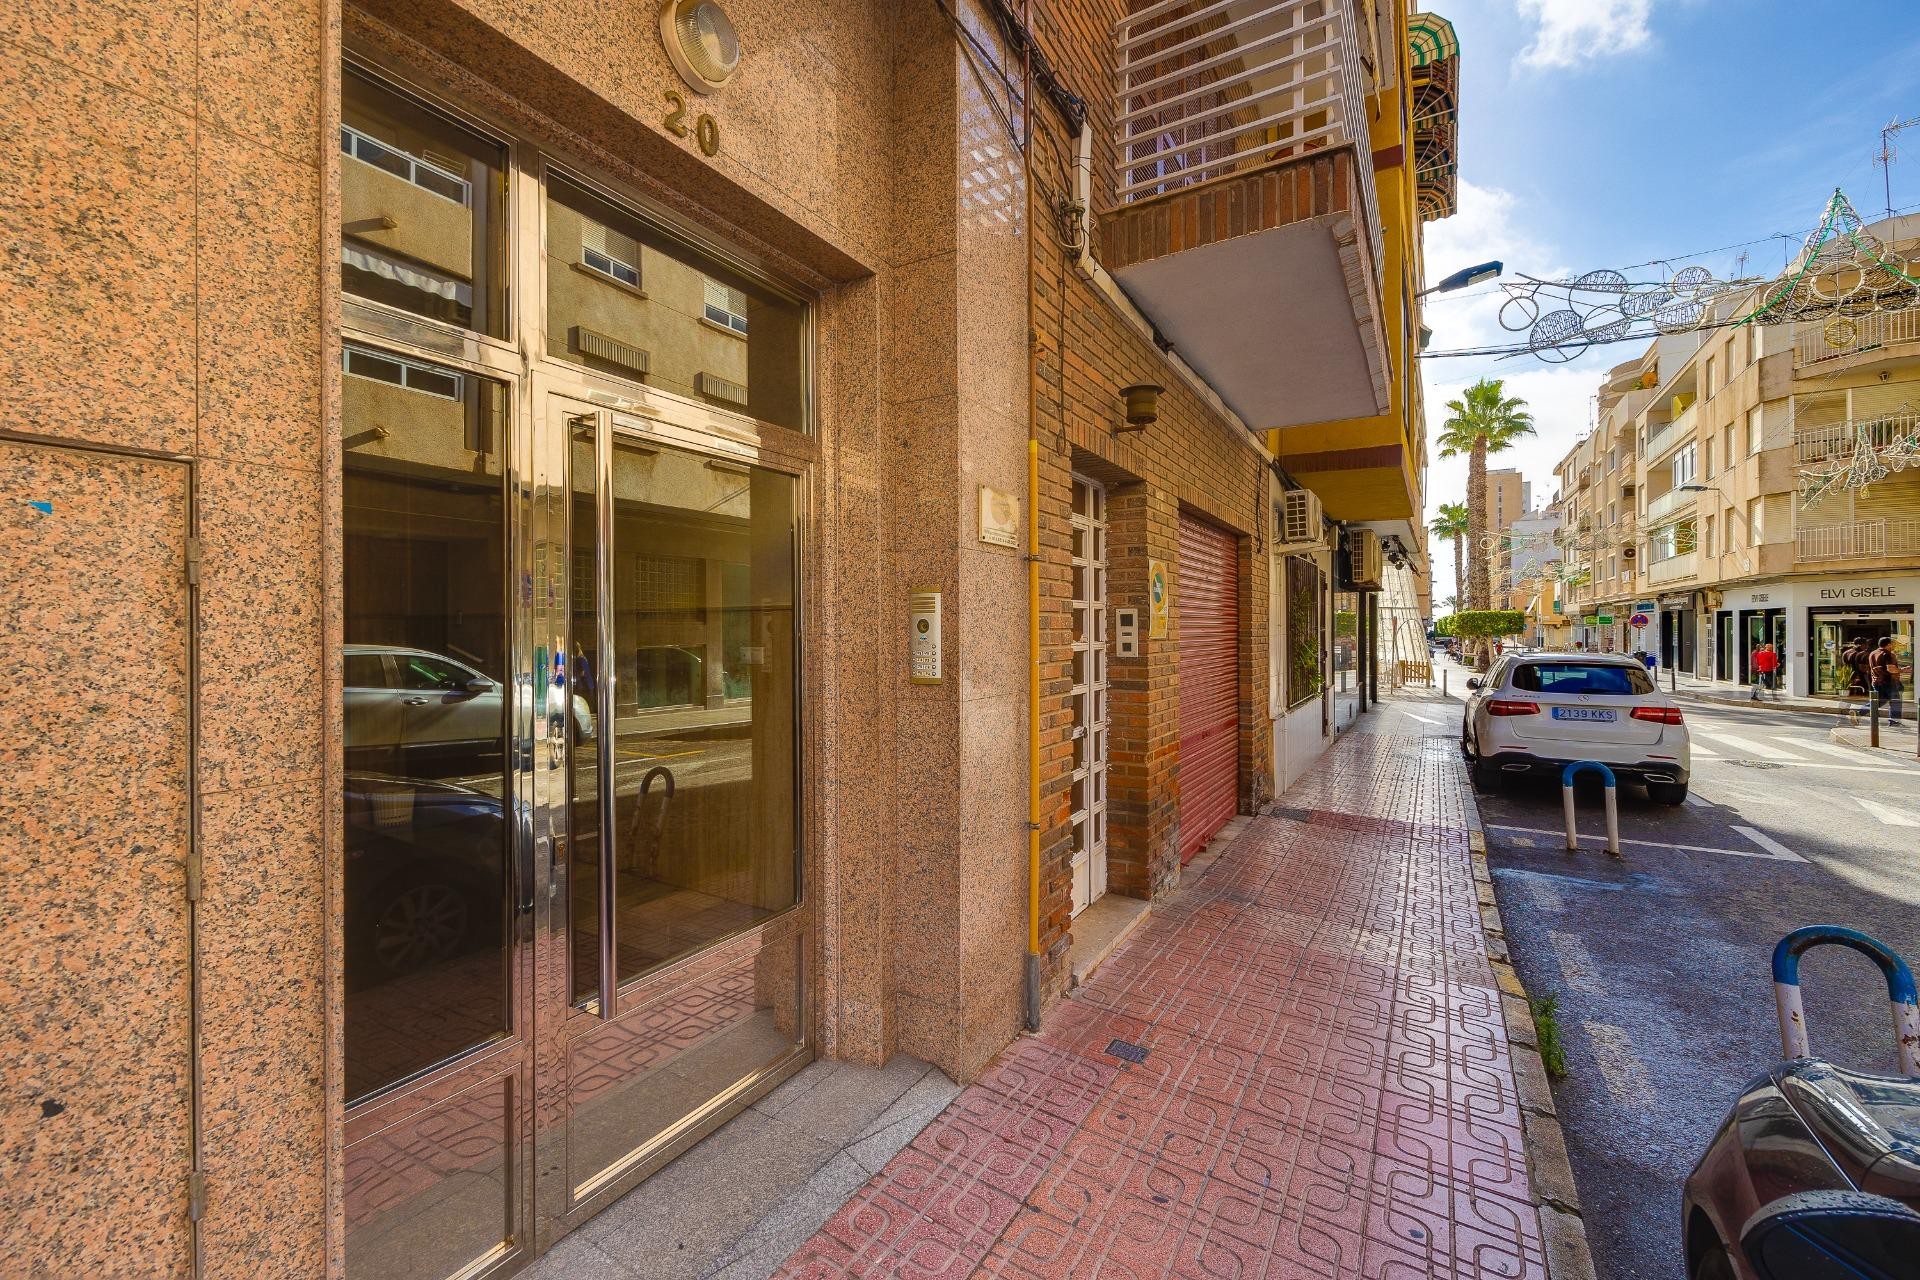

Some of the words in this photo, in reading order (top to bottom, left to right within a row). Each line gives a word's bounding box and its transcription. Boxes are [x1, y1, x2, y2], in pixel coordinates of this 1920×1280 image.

[663, 90, 720, 157] 20
[1820, 589, 1845, 599] ELVI
[1850, 586, 1896, 598] GISELE
[1559, 709, 1588, 718] 2139
[1591, 710, 1613, 720] KKS
